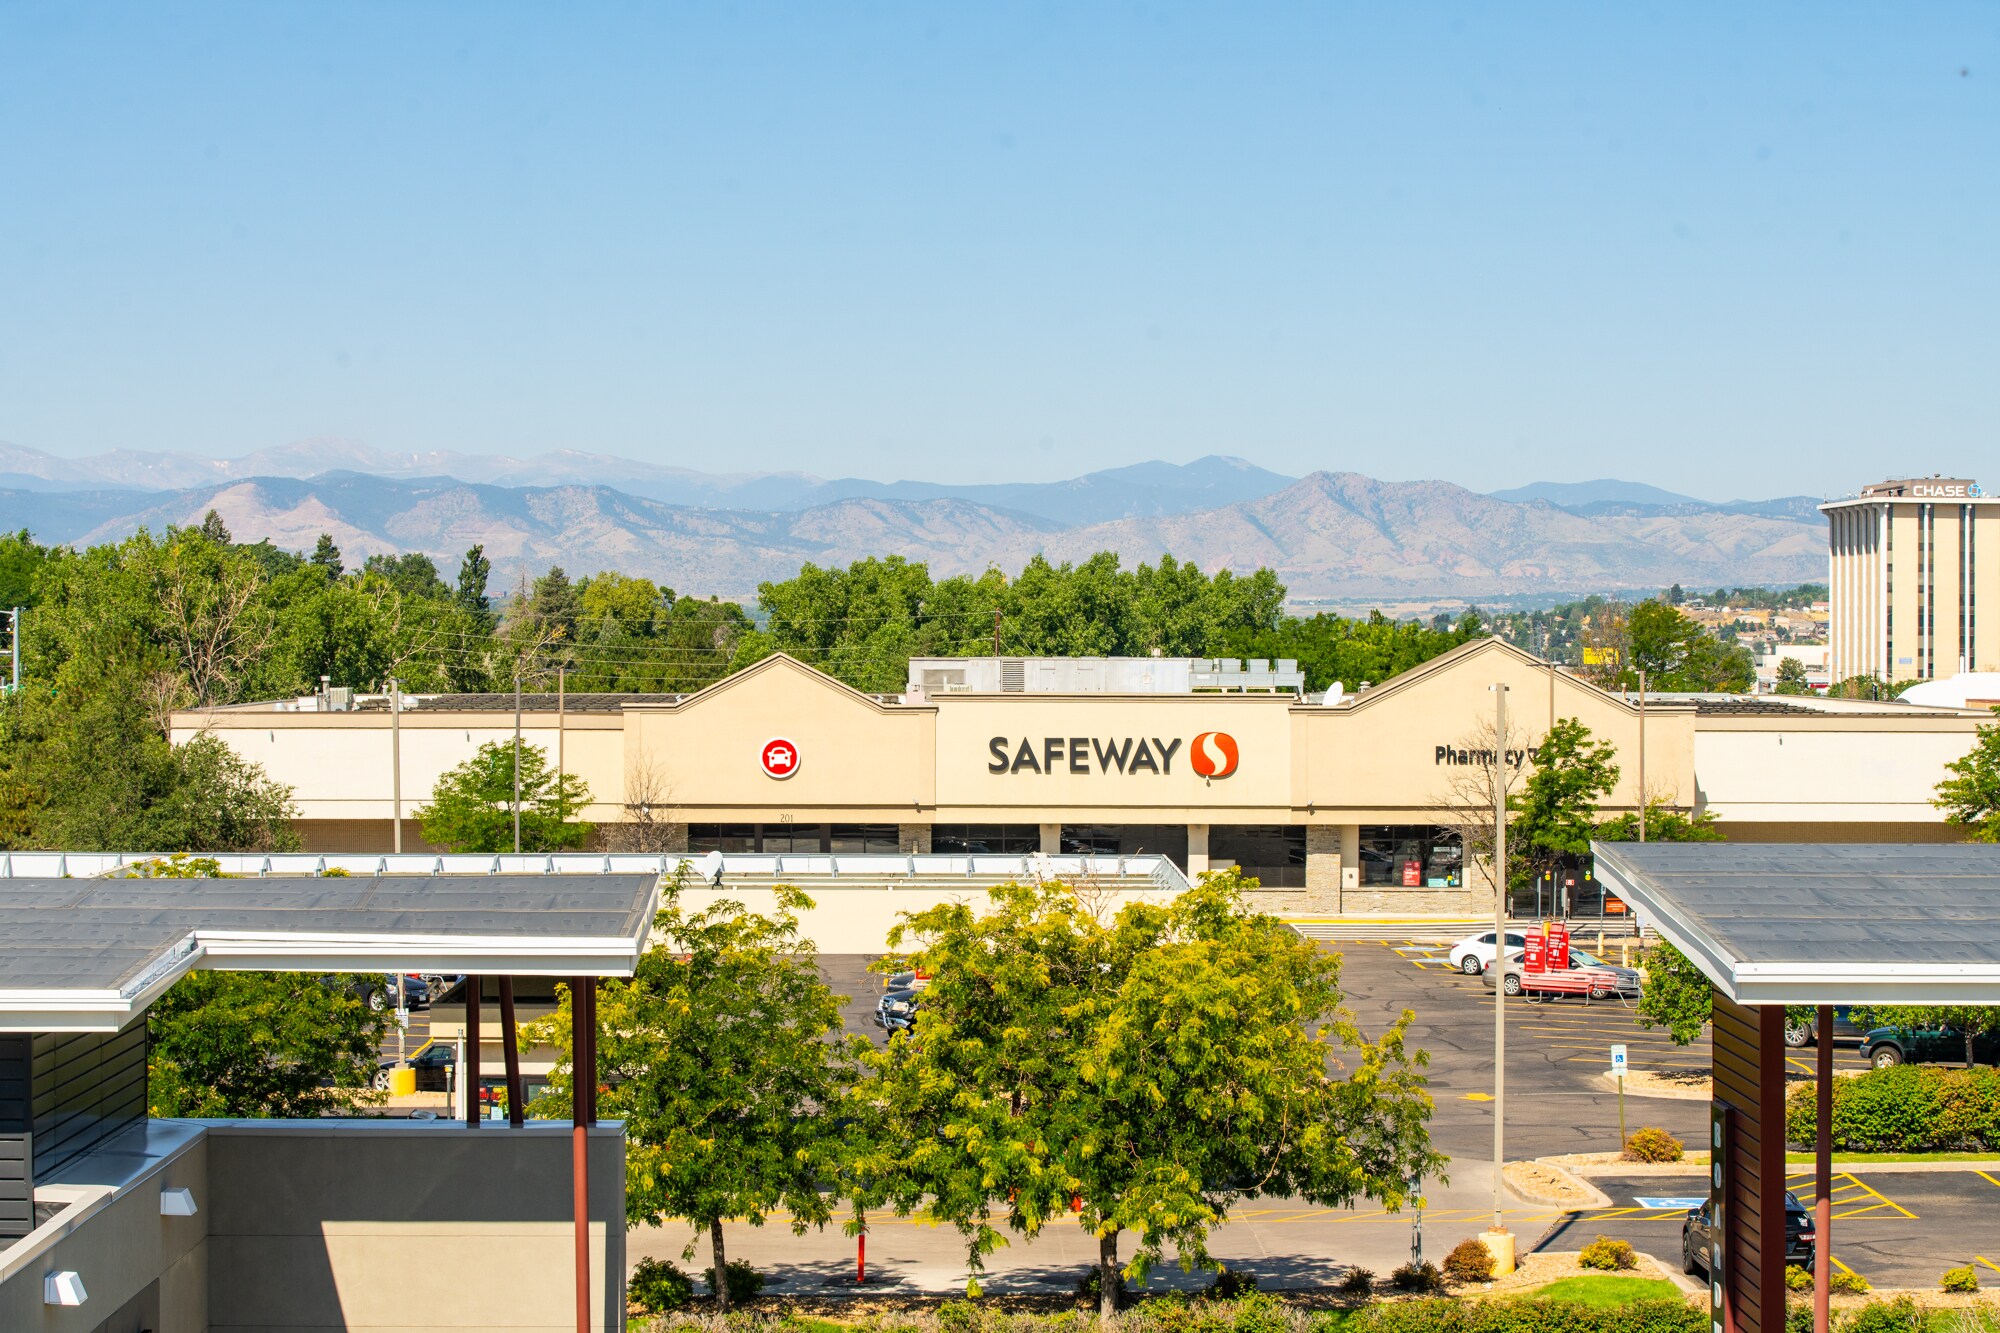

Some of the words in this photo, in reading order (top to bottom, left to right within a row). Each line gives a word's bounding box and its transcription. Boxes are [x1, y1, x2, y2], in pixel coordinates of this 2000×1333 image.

[1913, 485, 1965, 497] CHASE
[988, 736, 1182, 775] SAFEWAY
[780, 813, 793, 823] 201
